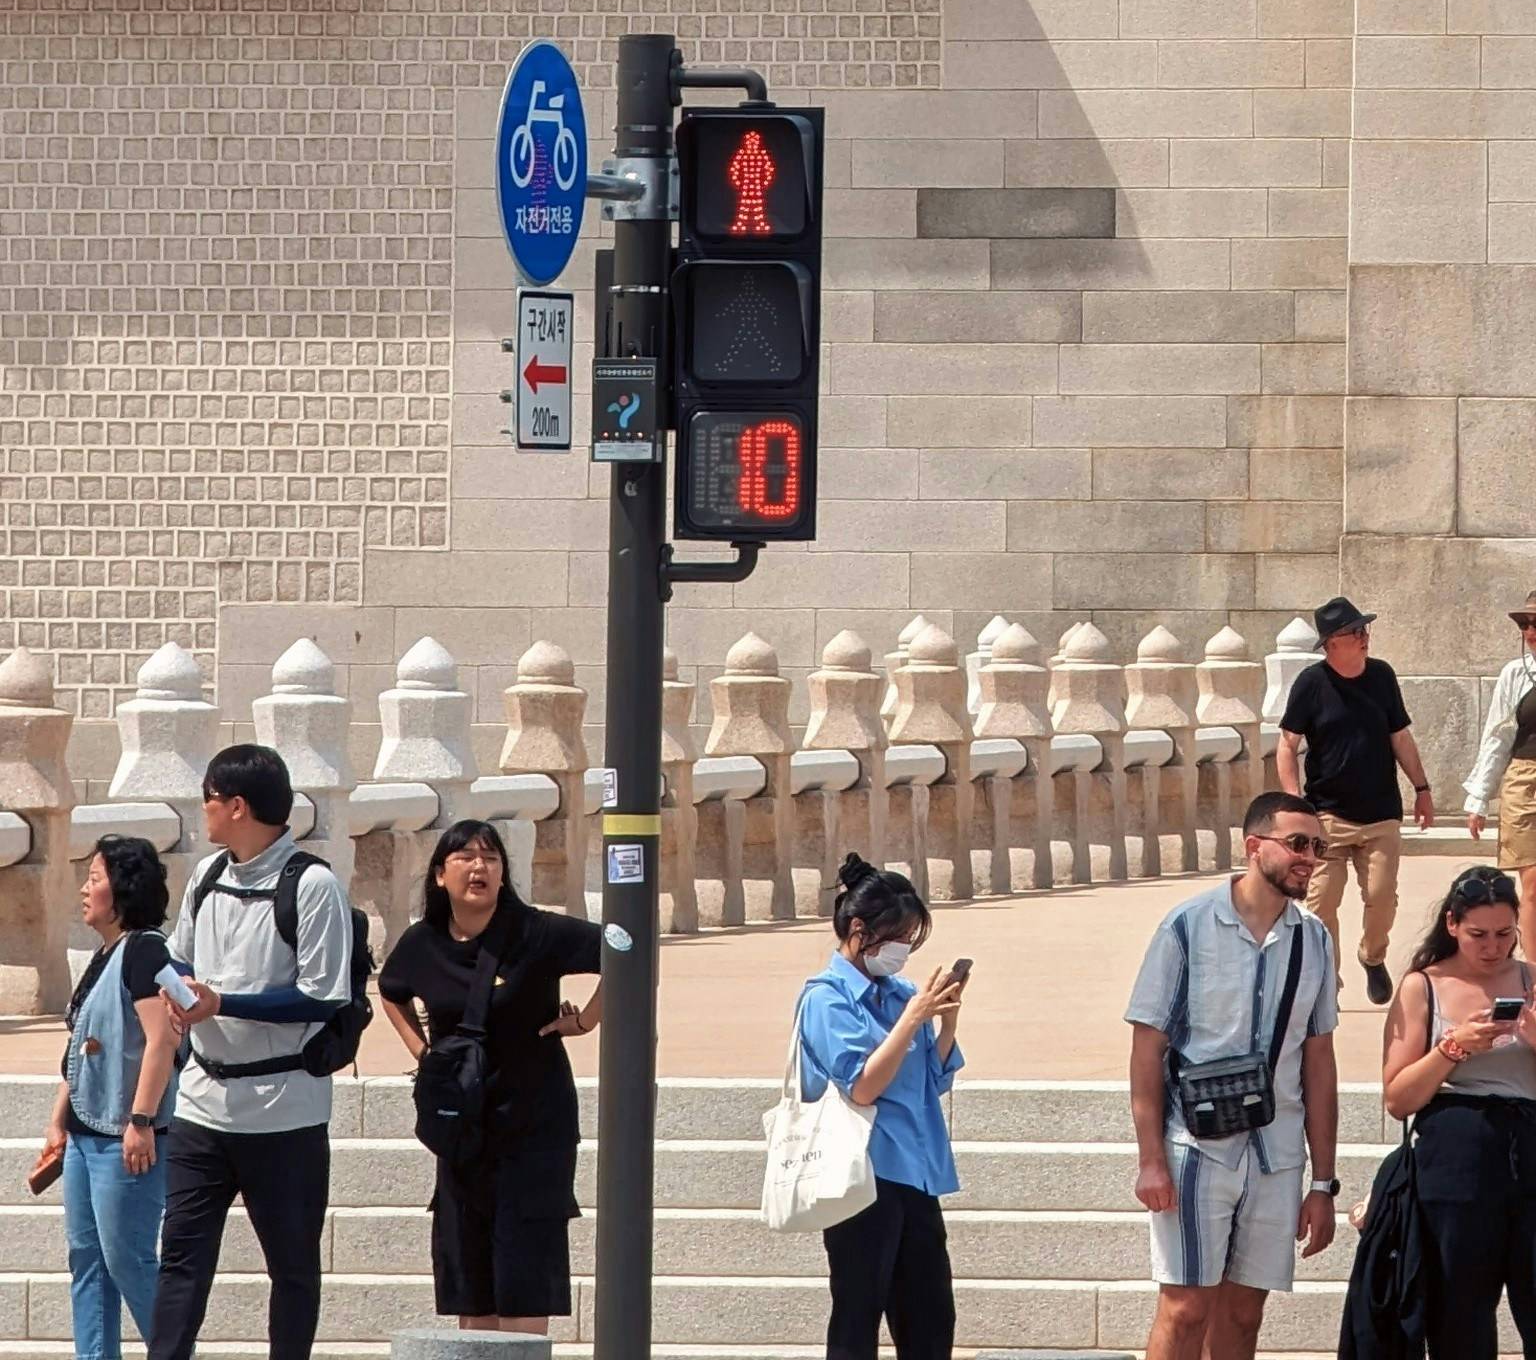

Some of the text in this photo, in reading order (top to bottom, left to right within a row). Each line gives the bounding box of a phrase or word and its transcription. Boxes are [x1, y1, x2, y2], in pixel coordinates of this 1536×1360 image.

[514, 204, 573, 234] 자전거전용
[527, 308, 566, 344] 구간시작
[531, 406, 560, 437] 200m
[739, 422, 798, 516] 10
